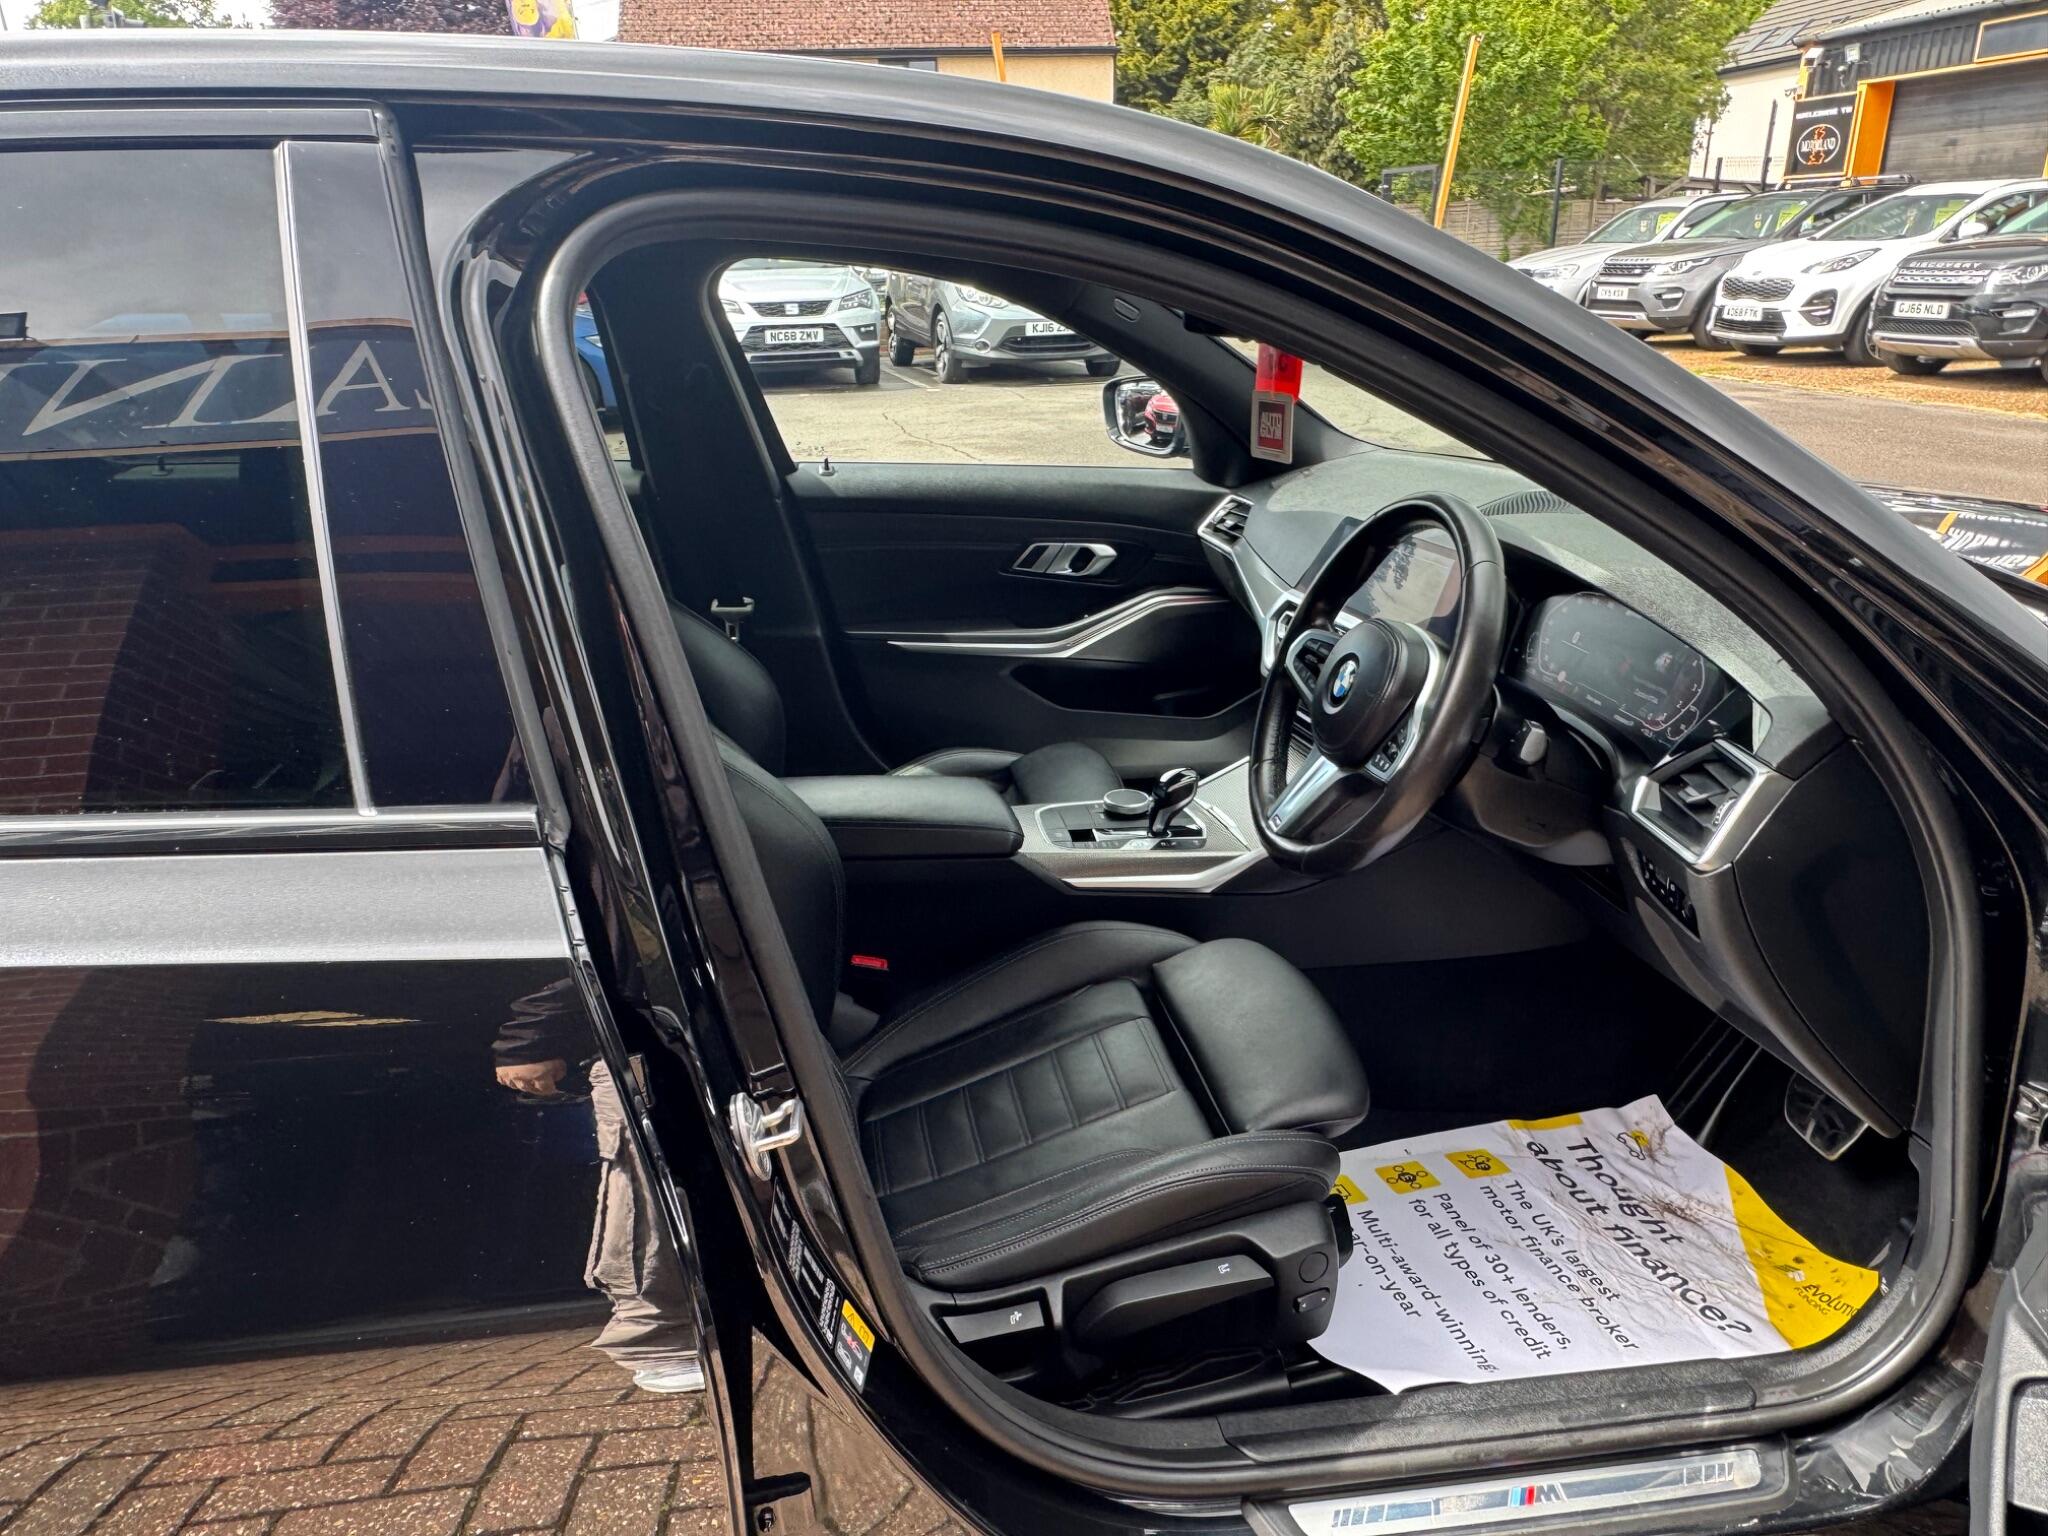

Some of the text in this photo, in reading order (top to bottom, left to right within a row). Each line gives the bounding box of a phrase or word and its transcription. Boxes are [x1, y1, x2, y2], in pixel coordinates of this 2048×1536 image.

[770, 330, 819, 341] NC68 ZMV
[1480, 1185, 1640, 1349] motor finance broker
[1505, 1179, 1533, 1210] The
[1561, 1249, 1621, 1301] largest
[1526, 1140, 1753, 1334] about finance?
[1567, 1137, 1685, 1245] Thought
[1408, 1198, 1551, 1360] for all types of credit
[1433, 1193, 1572, 1350] Panel of 30+ lenders,
